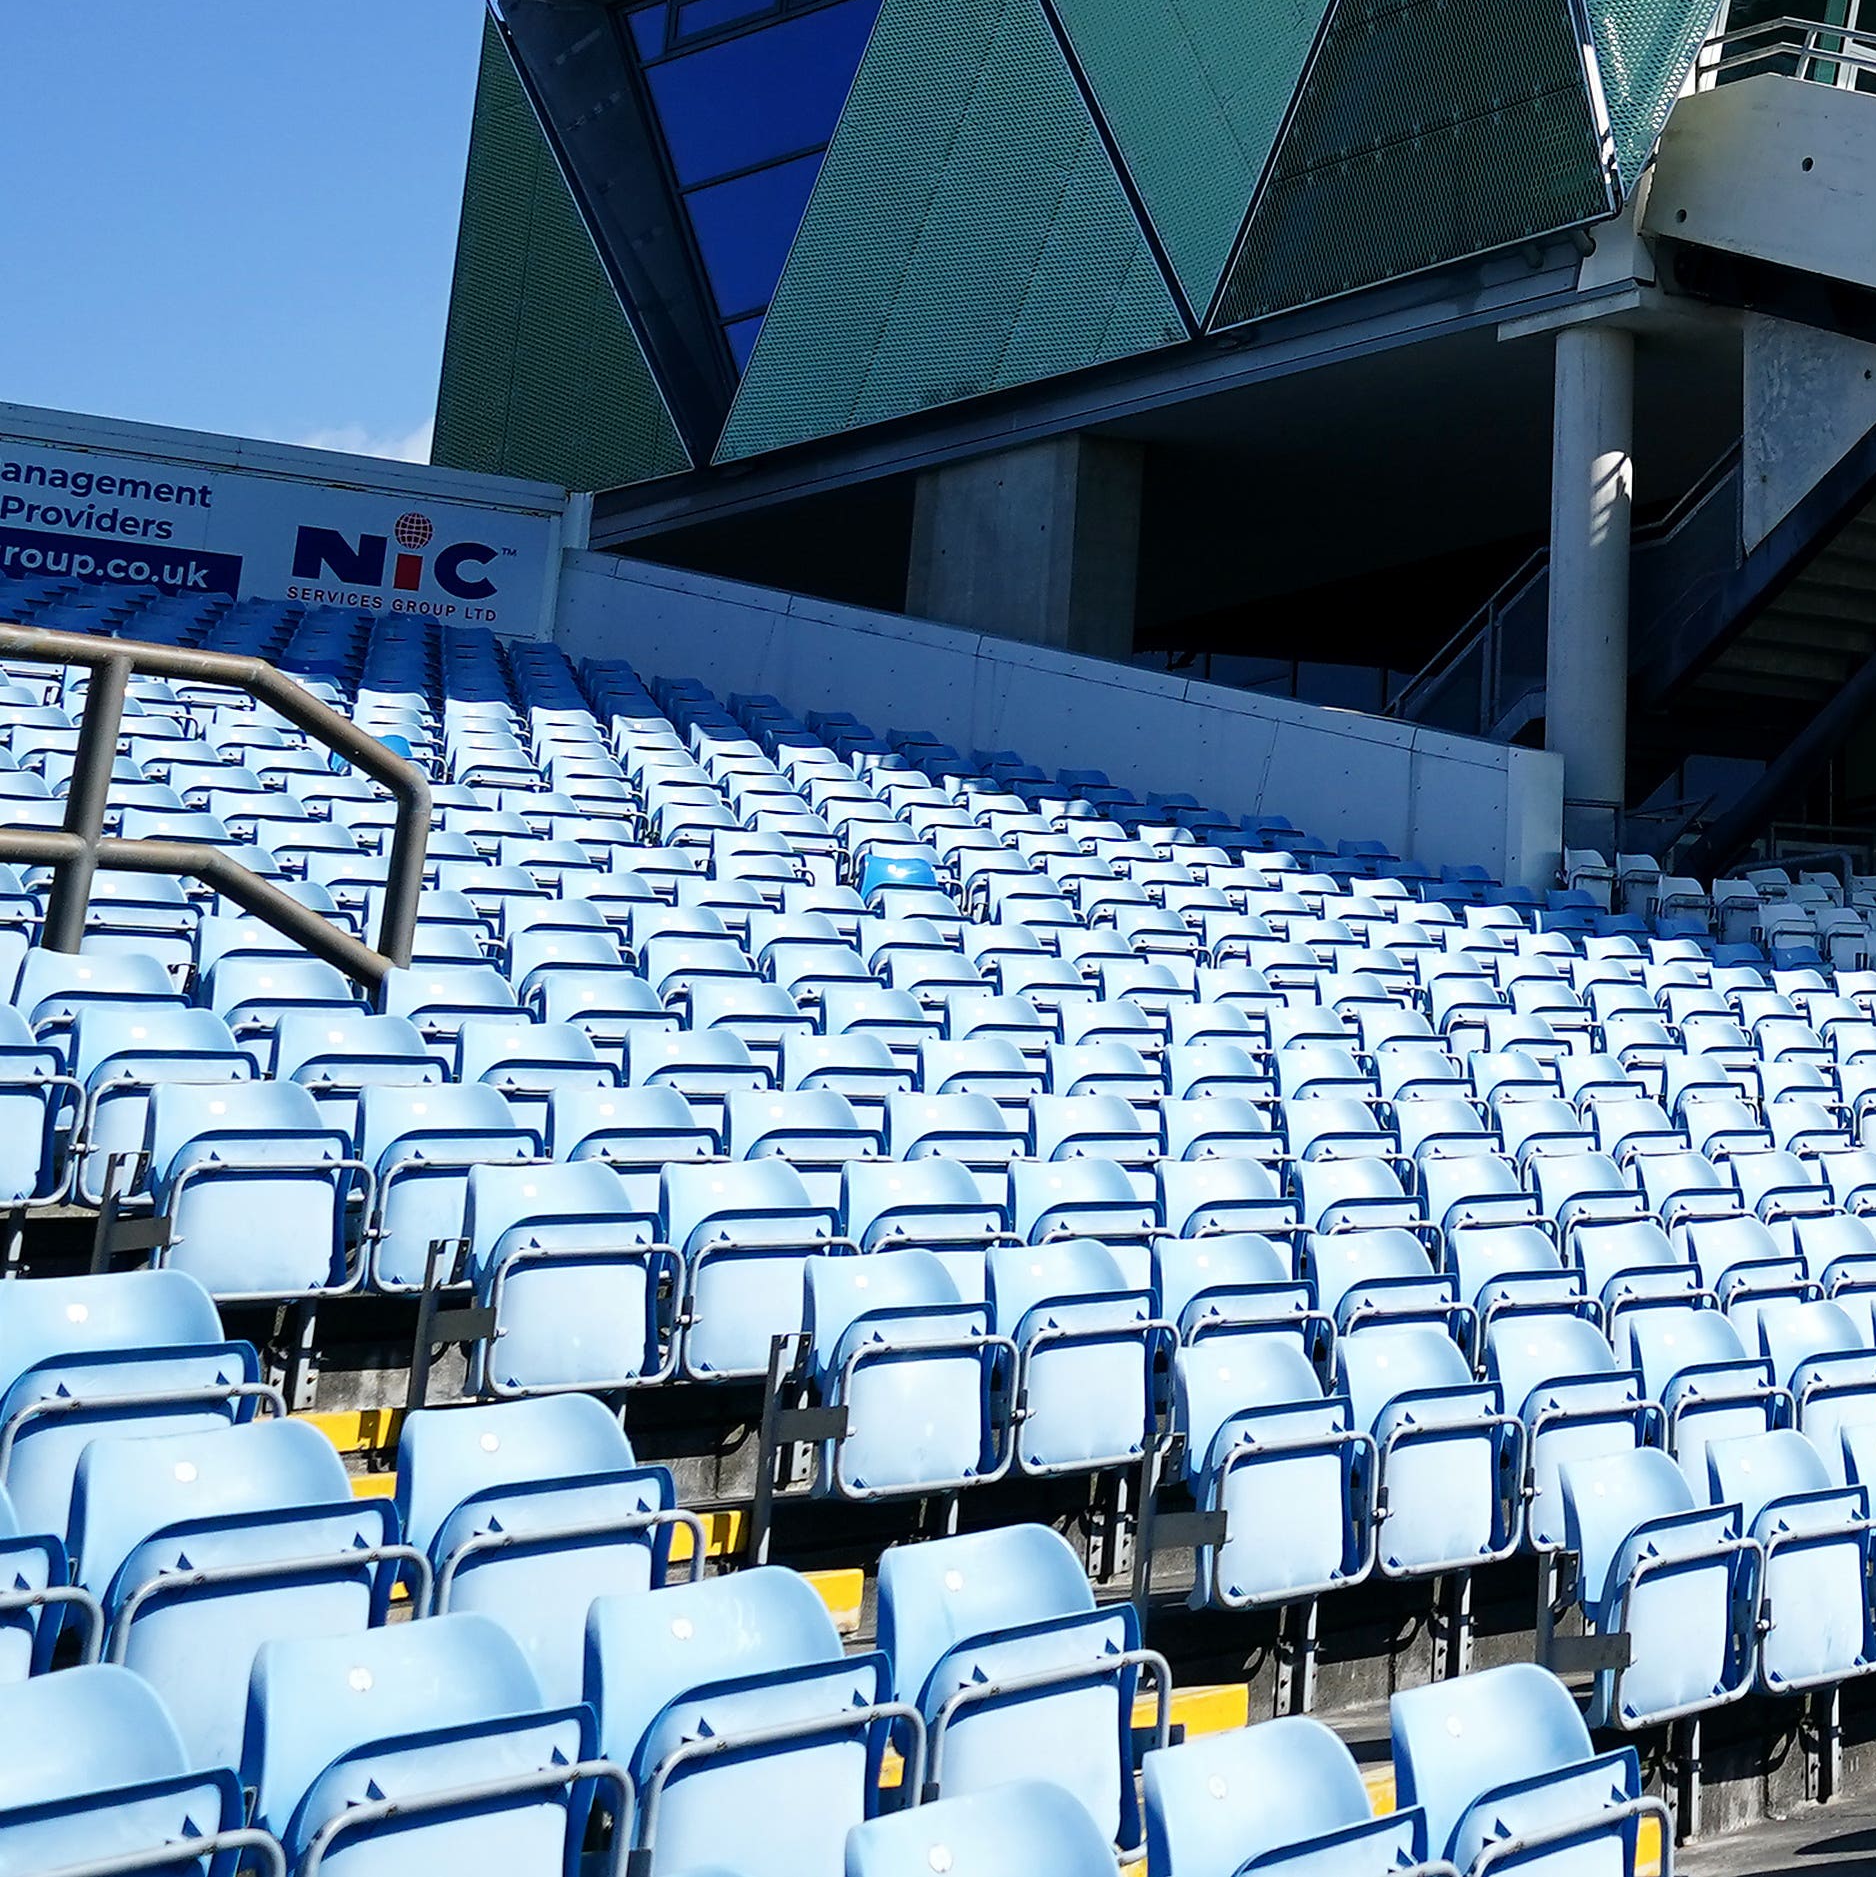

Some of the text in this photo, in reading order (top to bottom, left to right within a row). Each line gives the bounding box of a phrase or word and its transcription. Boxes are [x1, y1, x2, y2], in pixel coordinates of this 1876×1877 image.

[0, 495, 174, 539] Providers
[0, 545, 209, 589] roup.co.uk
[286, 586, 497, 622] SERVICES GROUP LTD
